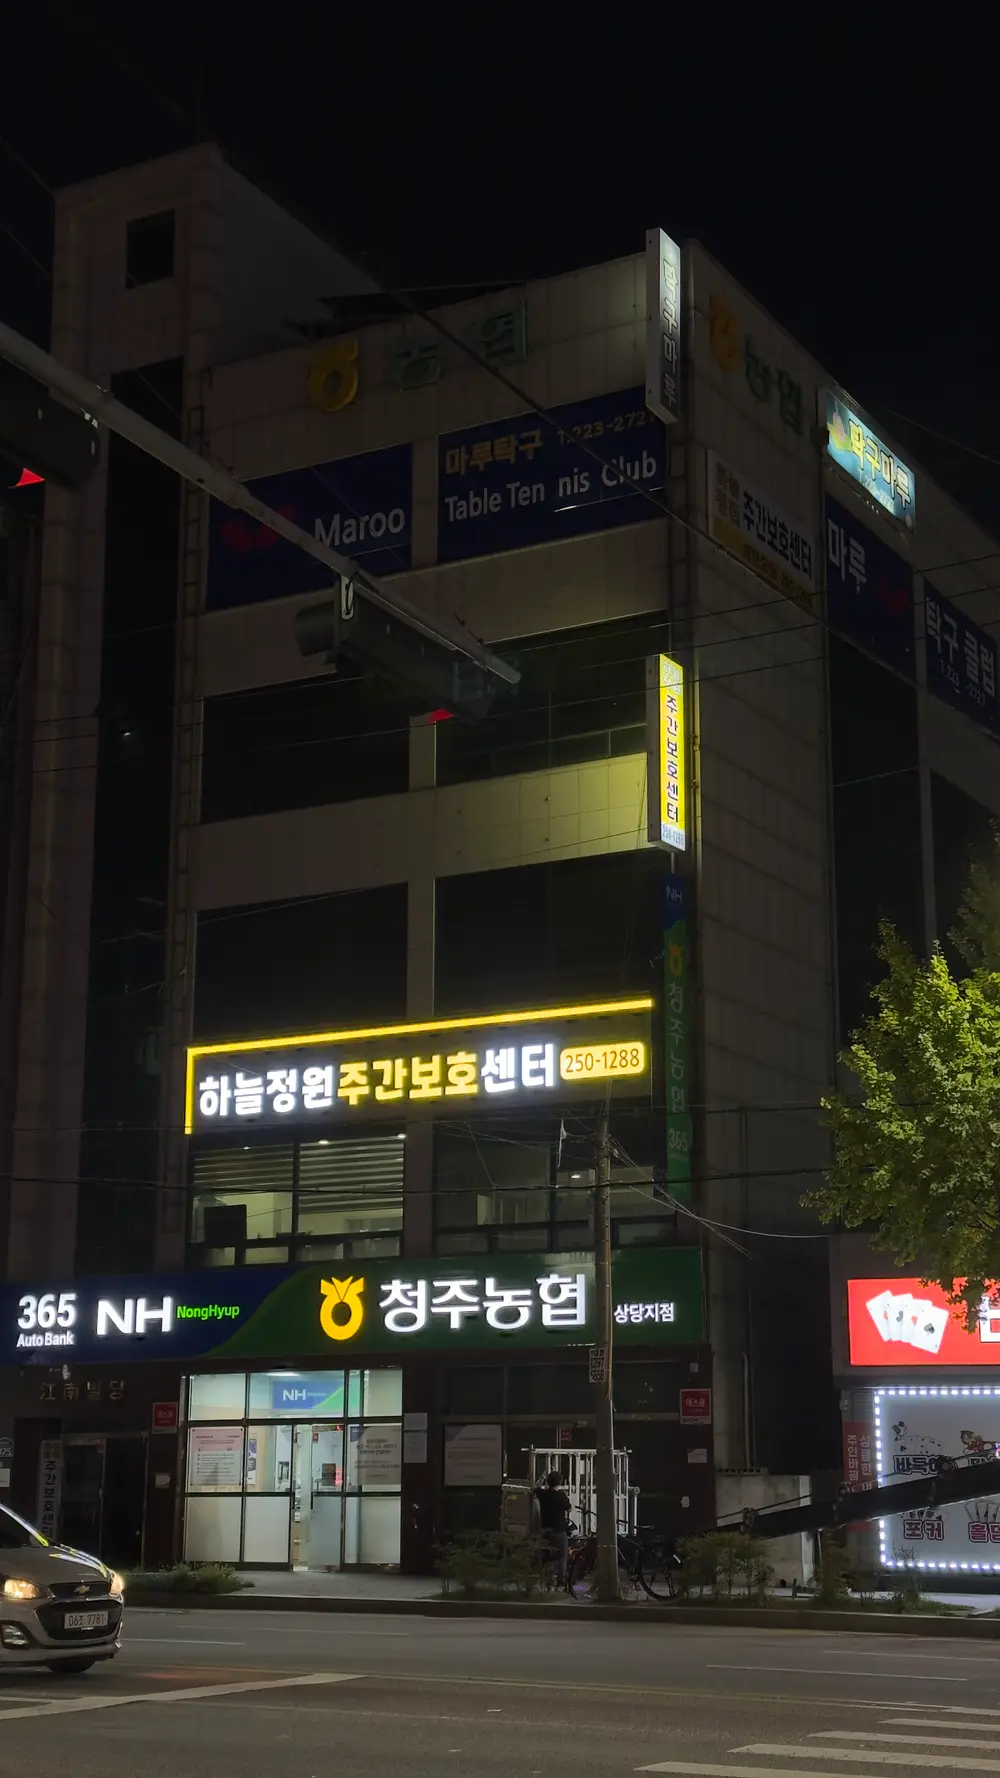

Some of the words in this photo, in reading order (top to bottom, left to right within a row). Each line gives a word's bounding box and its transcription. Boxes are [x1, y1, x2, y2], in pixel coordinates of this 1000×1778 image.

[445, 428, 544, 476] 마루탁구
[848, 419, 912, 510] 탁구마루
[444, 488, 502, 523] Table
[601, 449, 656, 487] Club
[313, 508, 406, 548] Maroo
[742, 489, 812, 579] 주간보호센터
[827, 518, 867, 596] 마루
[926, 596, 960, 664] 탁구
[964, 628, 996, 698] 클럽
[666, 693, 680, 824] 주간보호센터
[666, 884, 683, 905] NH
[564, 1048, 641, 1077] 250-1288
[667, 980, 685, 1115] 청주농협
[668, 1128, 689, 1152] 365
[17, 1292, 78, 1330] 365
[96, 1296, 174, 1336] NH
[176, 1304, 241, 1321] NongHyup
[379, 1273, 587, 1333] 청주농협
[613, 1302, 675, 1323] 상당지점
[16, 1333, 44, 1348] Auto
[44, 1331, 75, 1346] Bank
[282, 1388, 307, 1402] NH
[903, 1519, 945, 1541] 포커
